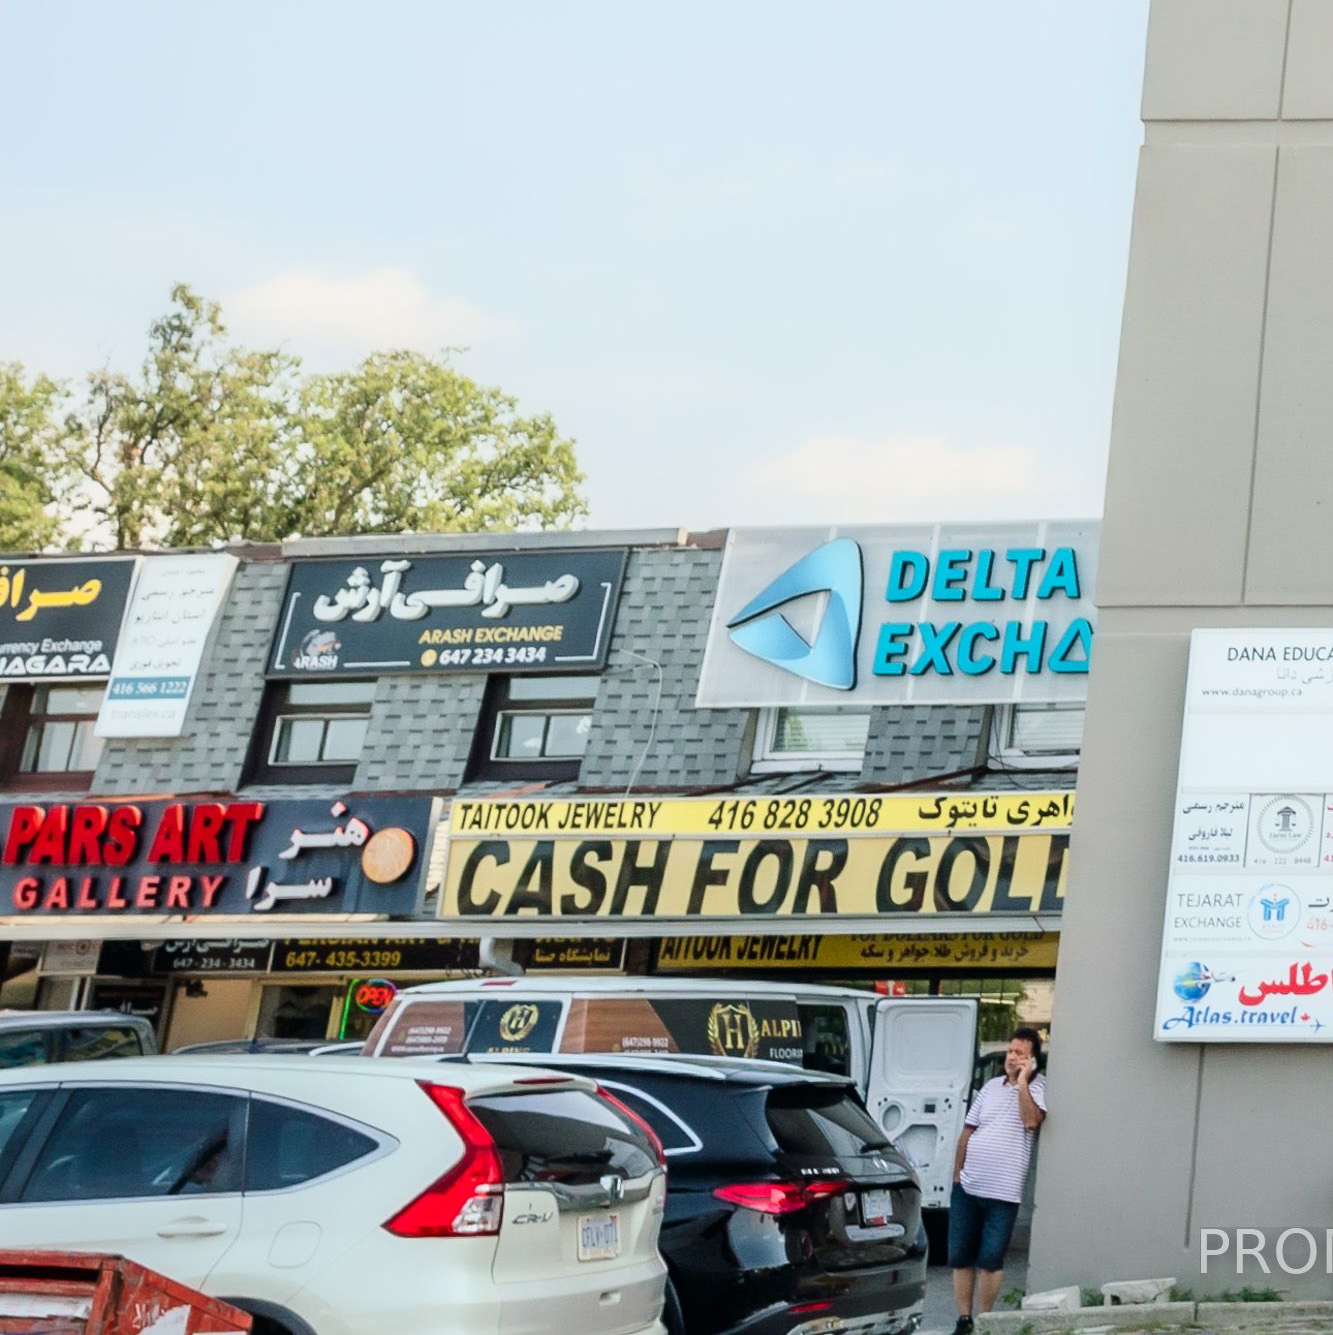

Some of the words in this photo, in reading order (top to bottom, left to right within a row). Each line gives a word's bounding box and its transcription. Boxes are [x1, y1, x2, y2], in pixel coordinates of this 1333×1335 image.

[313, 559, 411, 622] آرش
[390, 559, 580, 620] صرافی
[885, 547, 1081, 602] DELTA
[41, 638, 103, 655] Exchange
[419, 626, 472, 644] ARASH
[475, 625, 564, 643] EXCHANGE
[439, 648, 470, 665] 647
[471, 648, 503, 664] 234
[506, 646, 547, 663] 3434
[1227, 647, 1277, 662] DANA
[458, 803, 553, 830] TAITOOK
[558, 800, 663, 829] JEWELRY
[707, 800, 756, 830] 416
[762, 799, 811, 829] 828
[818, 798, 883, 828] 3908
[918, 796, 999, 828] تایتوک
[1007, 794, 1075, 826] اهری
[3, 804, 142, 866] PARS
[148, 802, 265, 864] ART
[278, 800, 369, 860] هنر
[12, 875, 225, 910] GALLERY
[246, 866, 333, 911] سرا
[456, 839, 673, 916] CASH
[686, 838, 849, 915] FOR
[1177, 893, 1243, 907] TEJARAT
[1174, 916, 1242, 928] EXCHANGE
[761, 1019, 802, 1038] ALPI
